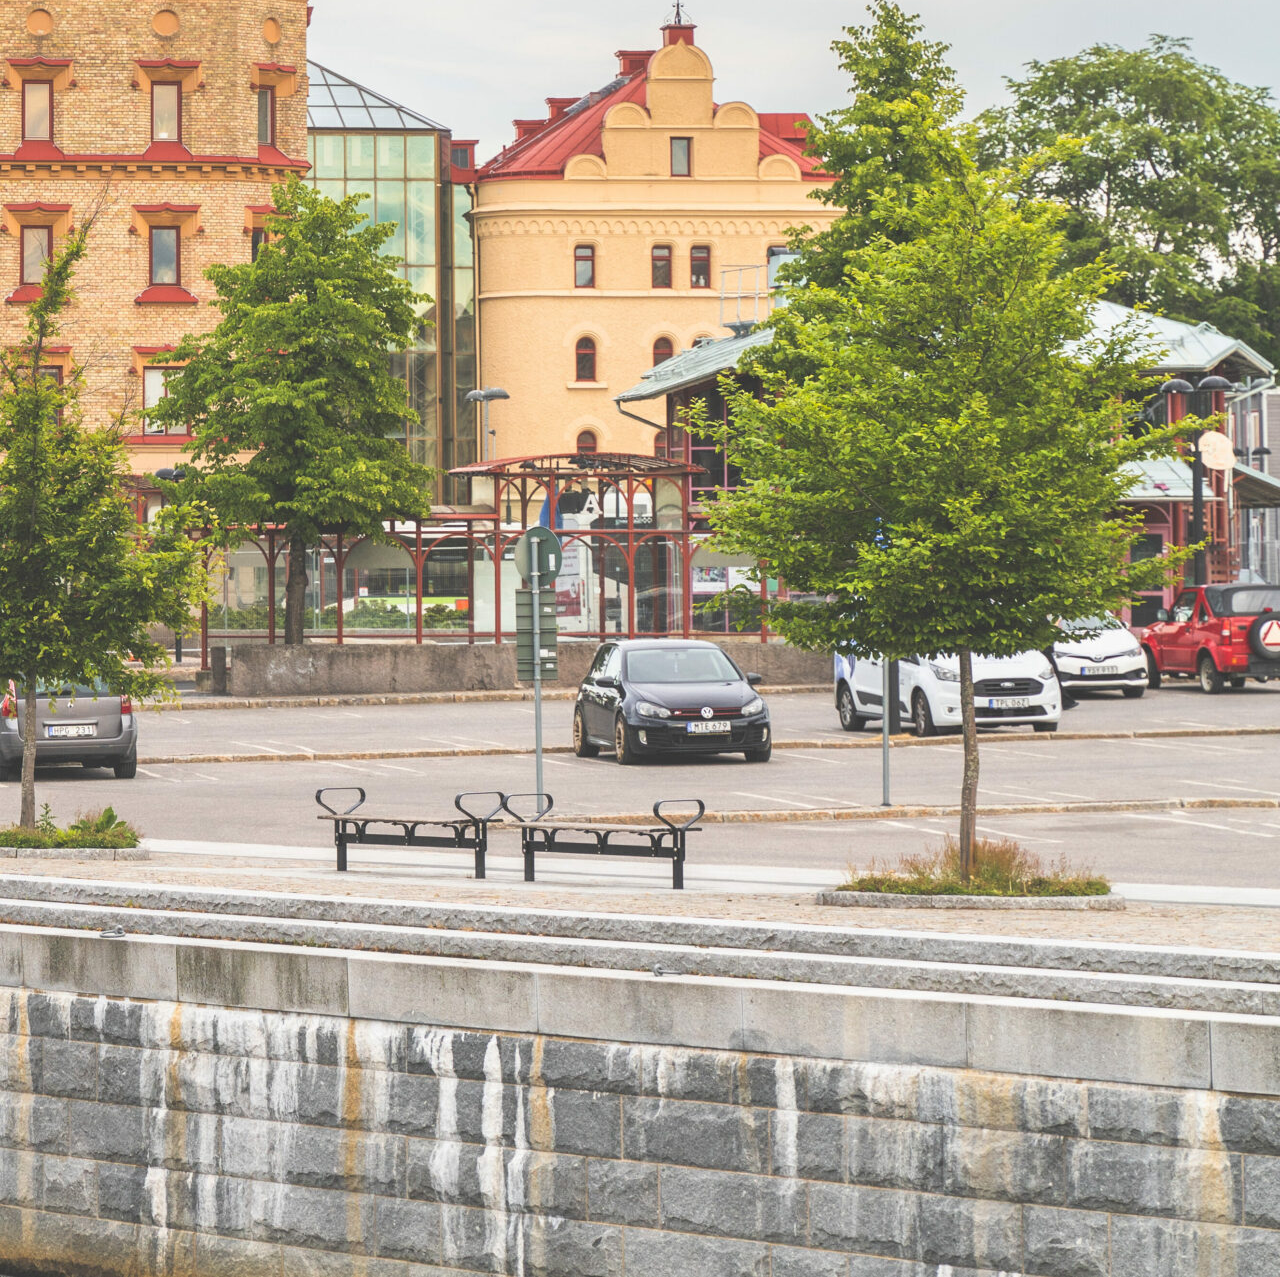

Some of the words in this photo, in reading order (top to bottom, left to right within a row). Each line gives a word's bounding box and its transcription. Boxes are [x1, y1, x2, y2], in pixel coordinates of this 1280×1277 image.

[53, 726, 70, 734] HPG
[75, 726, 91, 734] 231
[694, 723, 711, 731] MTE
[712, 722, 728, 730] 679
